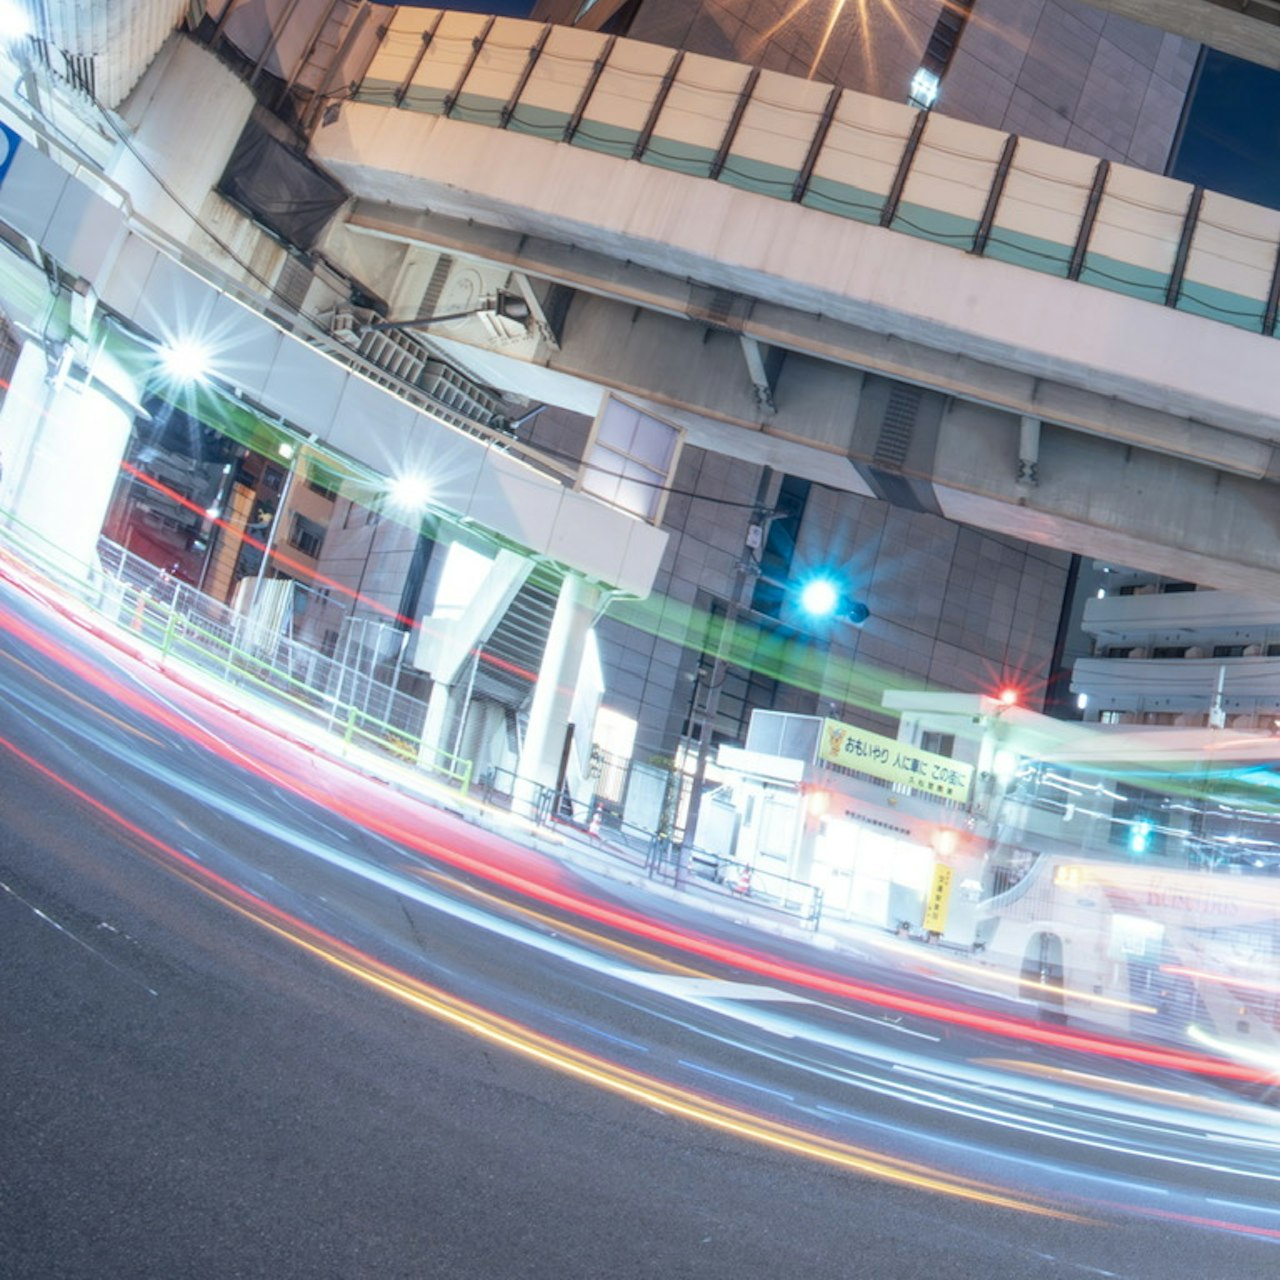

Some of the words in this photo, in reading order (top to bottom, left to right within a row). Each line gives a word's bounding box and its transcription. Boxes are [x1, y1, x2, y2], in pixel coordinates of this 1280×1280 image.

[844, 735, 890, 765] おもいやり
